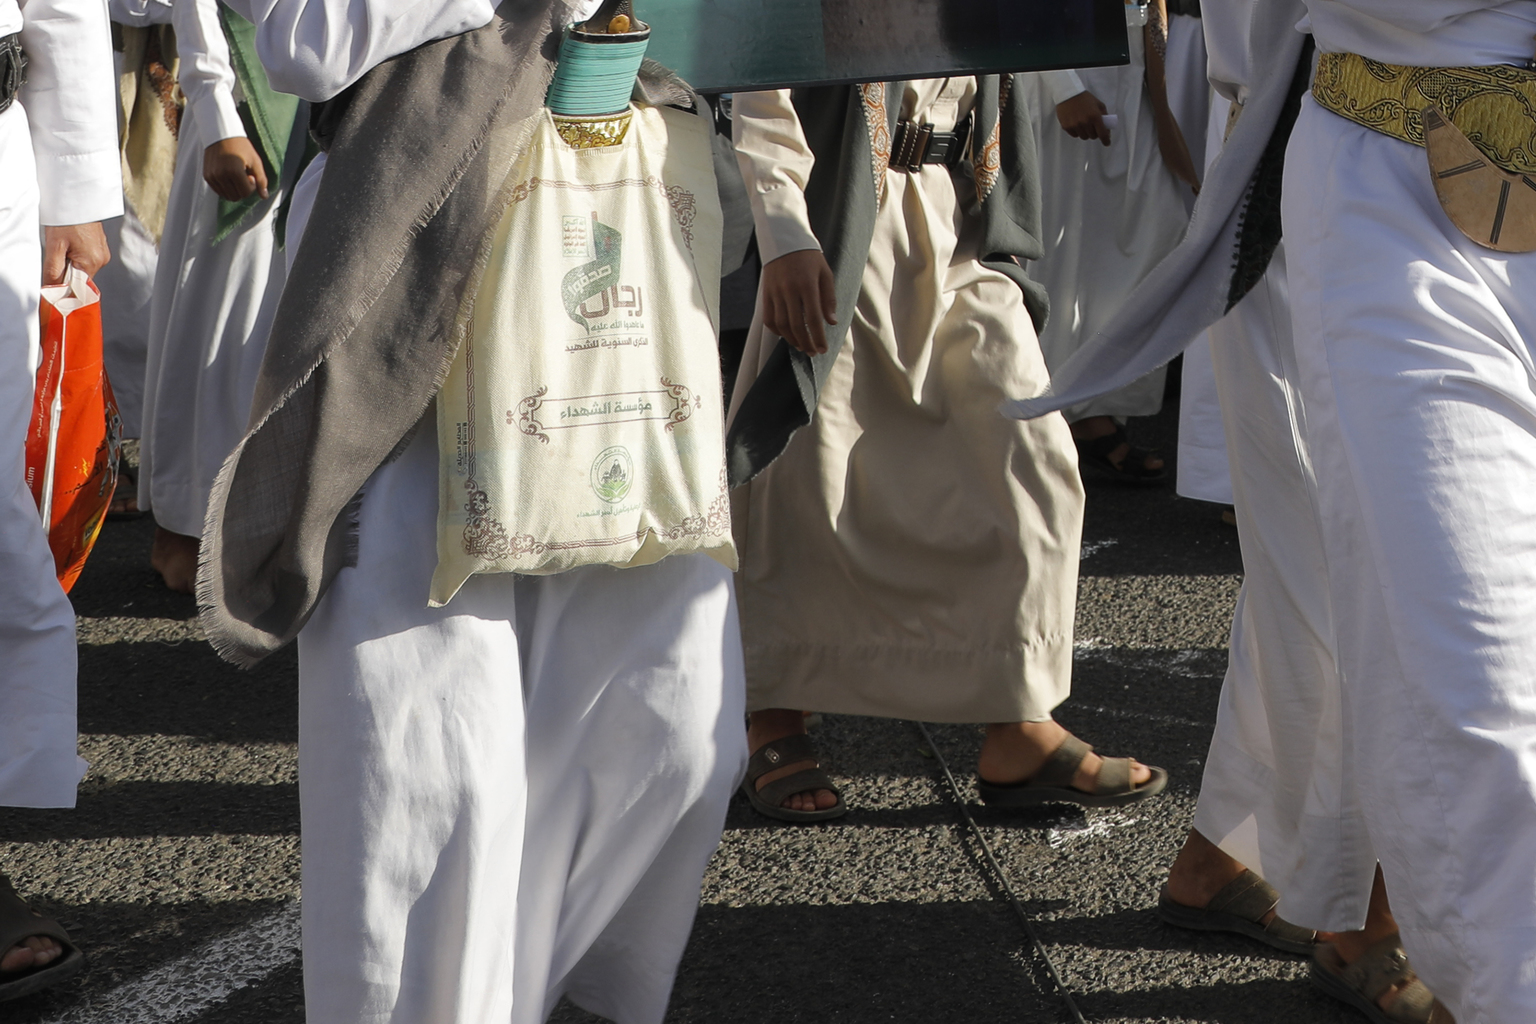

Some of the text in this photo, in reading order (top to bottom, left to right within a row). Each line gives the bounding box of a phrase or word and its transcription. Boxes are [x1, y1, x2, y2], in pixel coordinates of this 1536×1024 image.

[566, 264, 612, 296] صدقوا
[580, 282, 643, 320] رجال
[564, 339, 600, 355] للشهيد
[600, 337, 632, 350] السنوية
[560, 397, 652, 420] مؤسسة الشهداء
